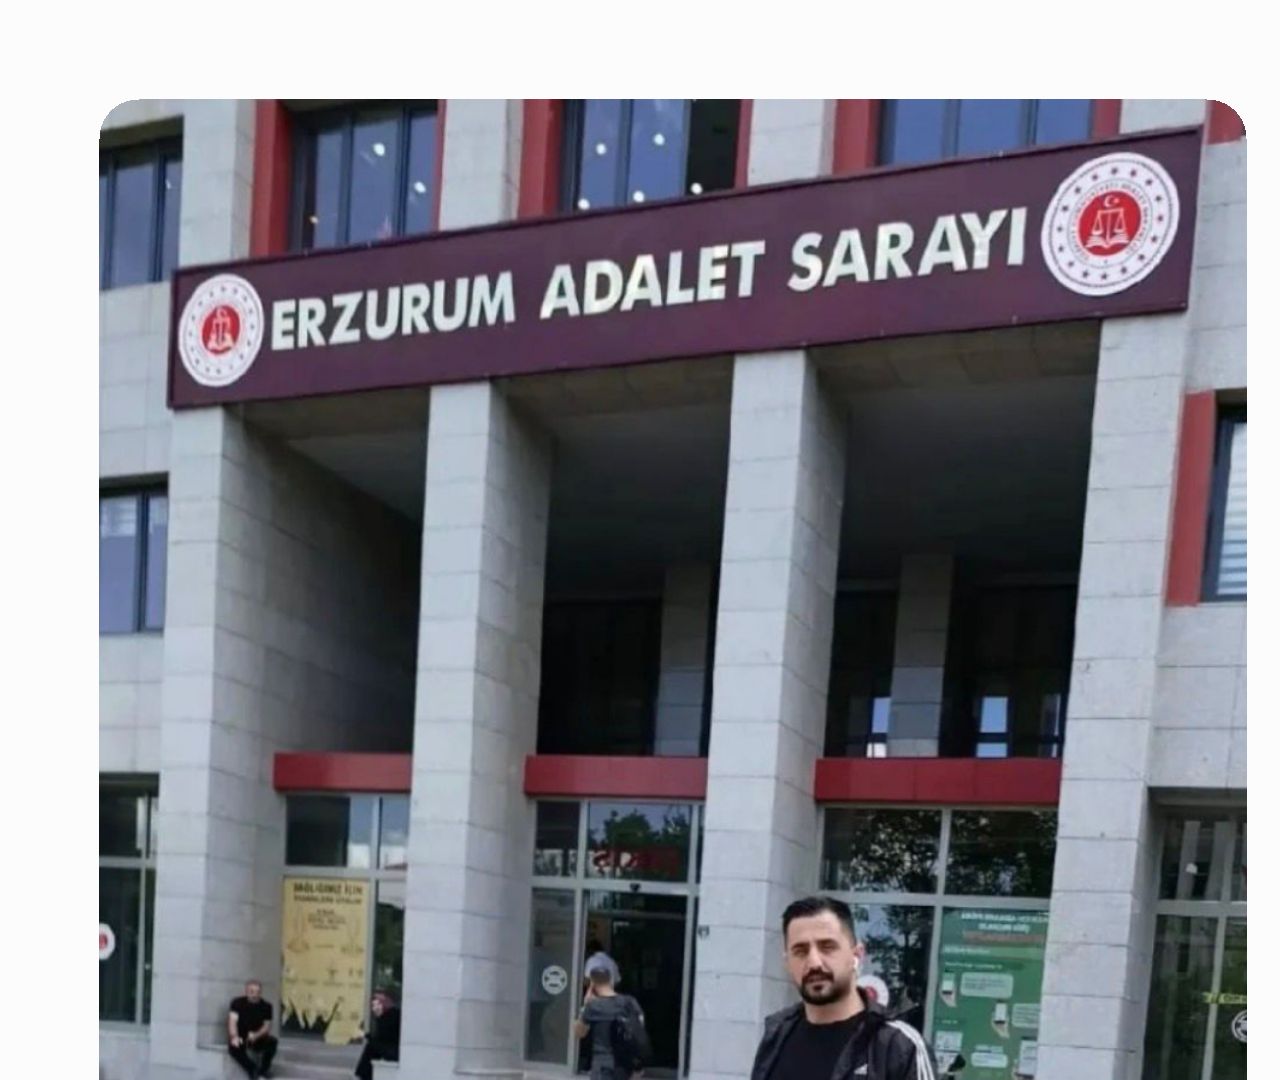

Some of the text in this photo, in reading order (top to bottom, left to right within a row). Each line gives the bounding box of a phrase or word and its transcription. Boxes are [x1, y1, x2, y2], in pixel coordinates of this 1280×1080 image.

[271, 271, 516, 351] ERZURUM
[540, 240, 767, 320] ADALET
[787, 207, 1027, 292] SARAYI
